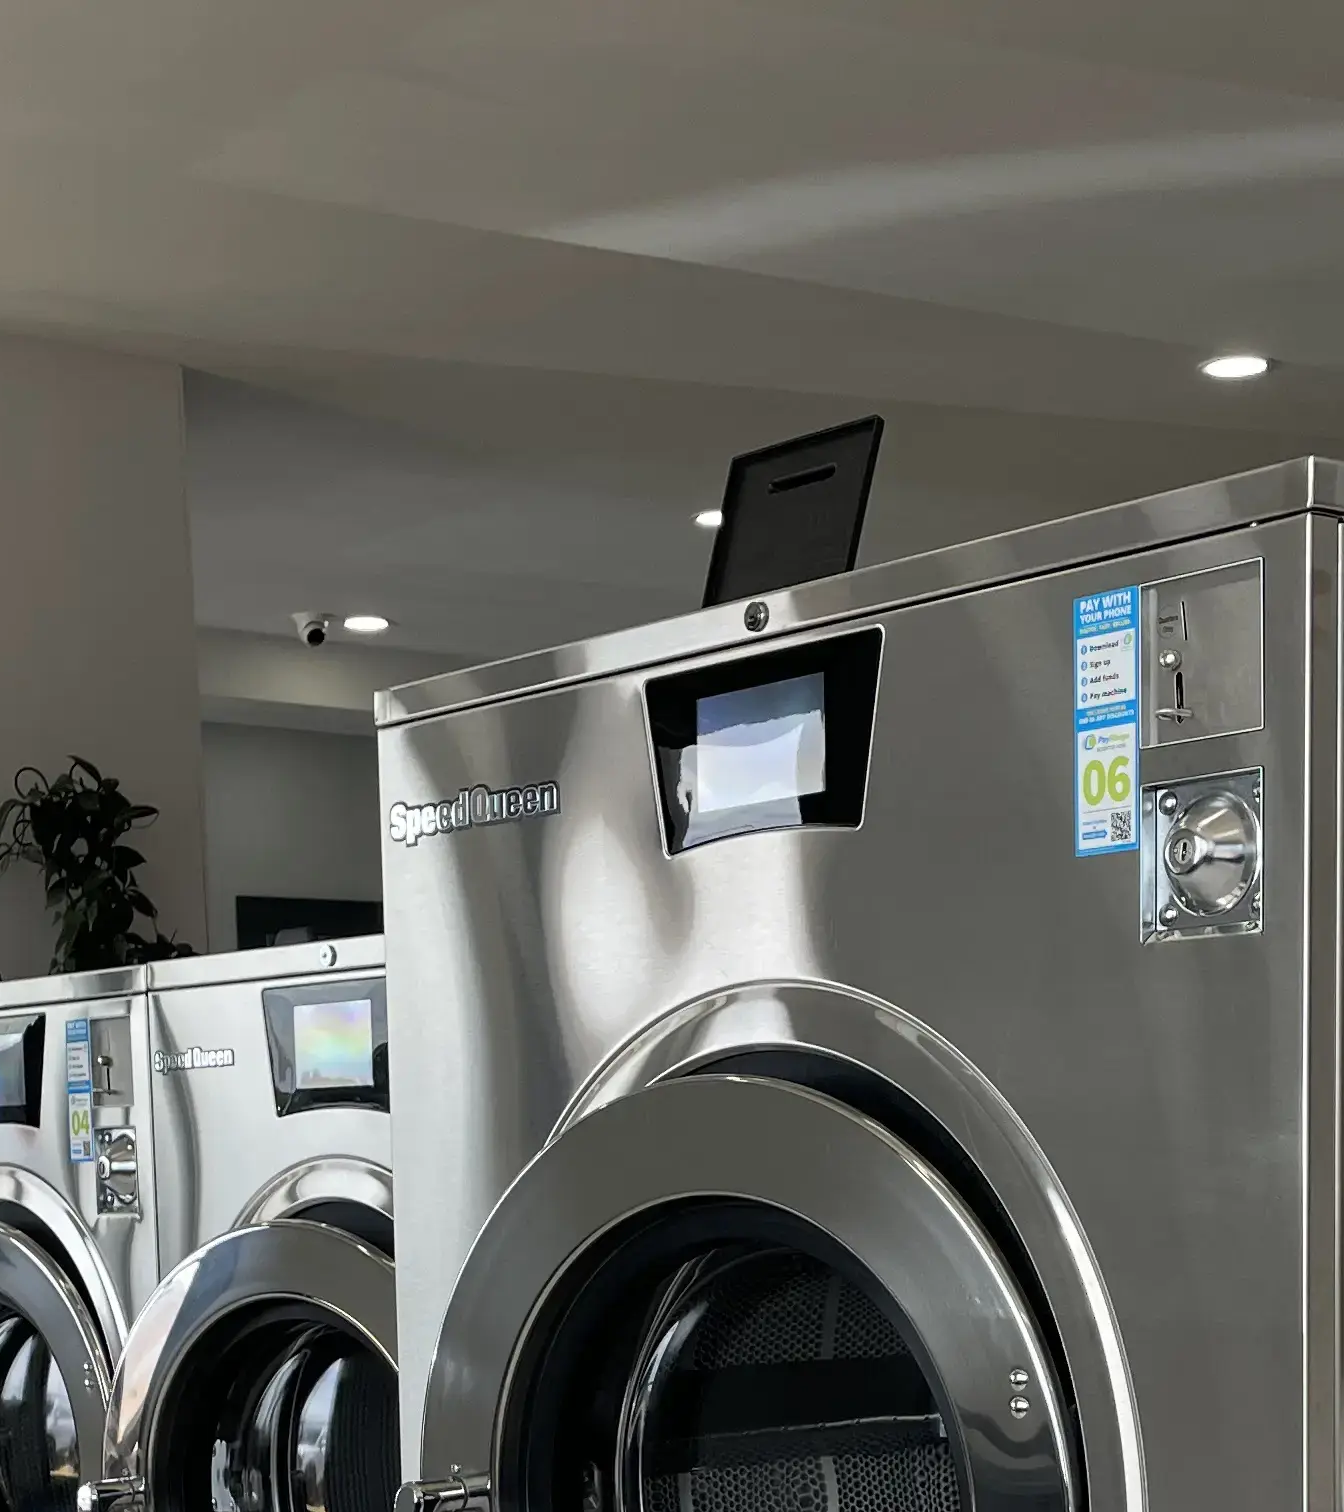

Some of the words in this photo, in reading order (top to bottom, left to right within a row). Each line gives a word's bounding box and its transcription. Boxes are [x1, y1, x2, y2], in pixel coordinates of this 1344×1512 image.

[1079, 597, 1101, 615] PAY
[1101, 590, 1132, 608] WITH
[1079, 611, 1103, 625] YOUR
[1103, 604, 1132, 620] PHONE
[1089, 640, 1120, 652] Download
[1089, 675, 1102, 683] Add
[1089, 692, 1101, 700] Pay
[1082, 755, 1132, 806] 06
[71, 1110, 90, 1136] 04
